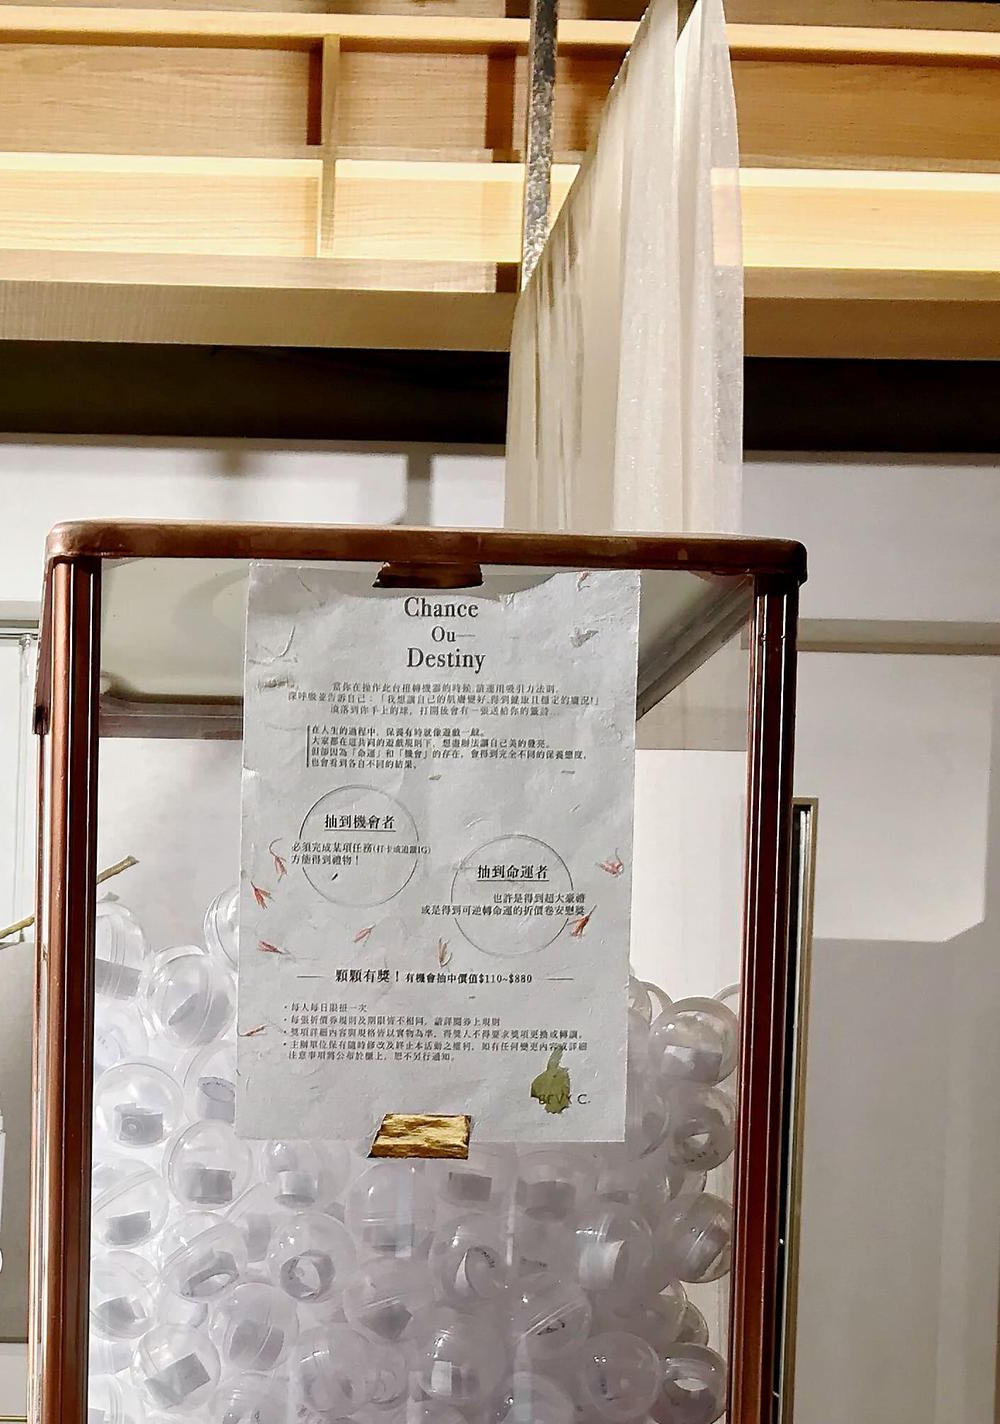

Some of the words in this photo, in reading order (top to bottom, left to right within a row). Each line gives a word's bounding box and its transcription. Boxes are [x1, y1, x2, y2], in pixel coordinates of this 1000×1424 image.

[403, 595, 480, 619] Chance
[431, 626, 457, 643] Ou
[406, 648, 486, 674] Destiny
[324, 814, 395, 829] 抽到機會者
[477, 864, 549, 879] 抽到命運者
